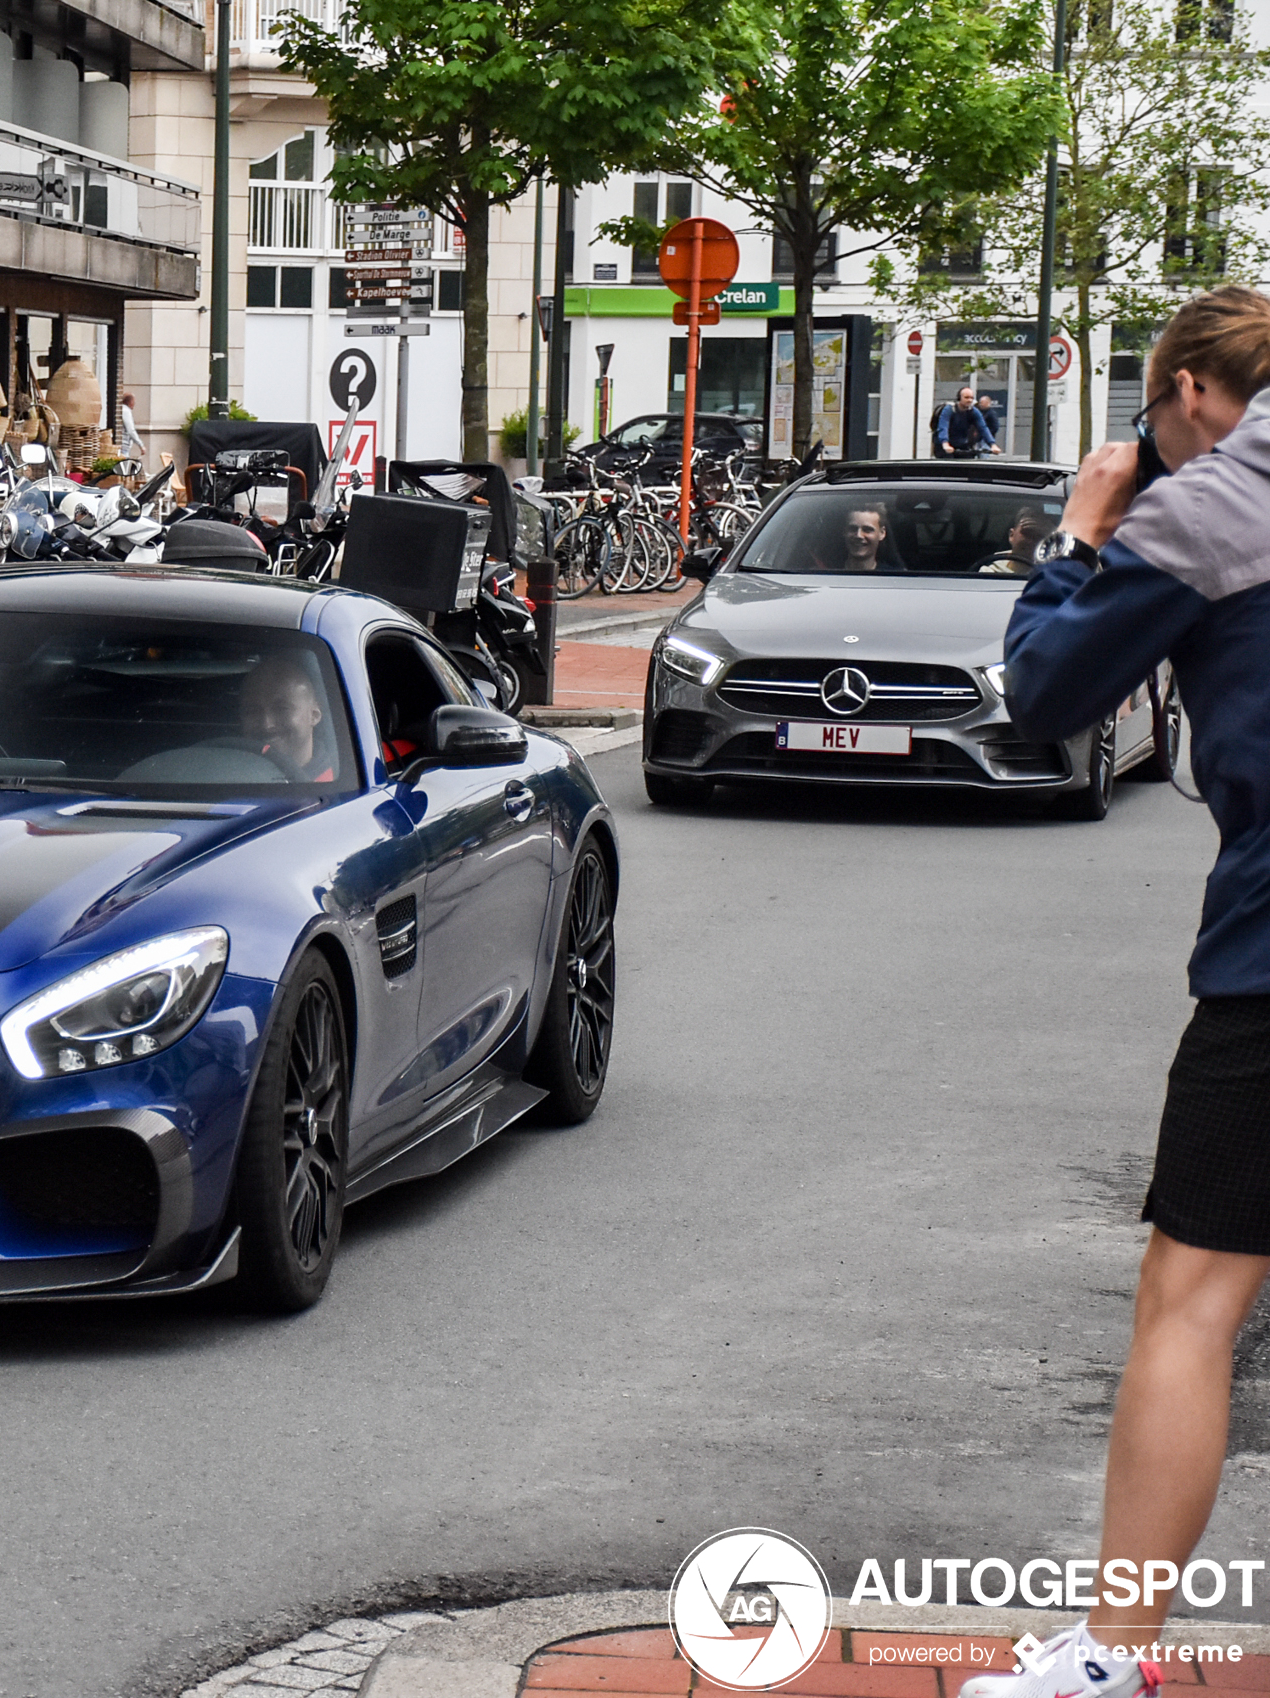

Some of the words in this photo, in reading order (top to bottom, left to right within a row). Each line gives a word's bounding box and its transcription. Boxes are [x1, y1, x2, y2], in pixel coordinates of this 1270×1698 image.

[372, 212, 400, 222] Politie
[369, 231, 381, 240] De
[383, 230, 411, 242] Marge
[356, 251, 382, 261] Stadion
[384, 250, 410, 260] Olivier
[714, 288, 767, 303] Crelan
[778, 736, 786, 746] B
[822, 726, 860, 749] MEV
